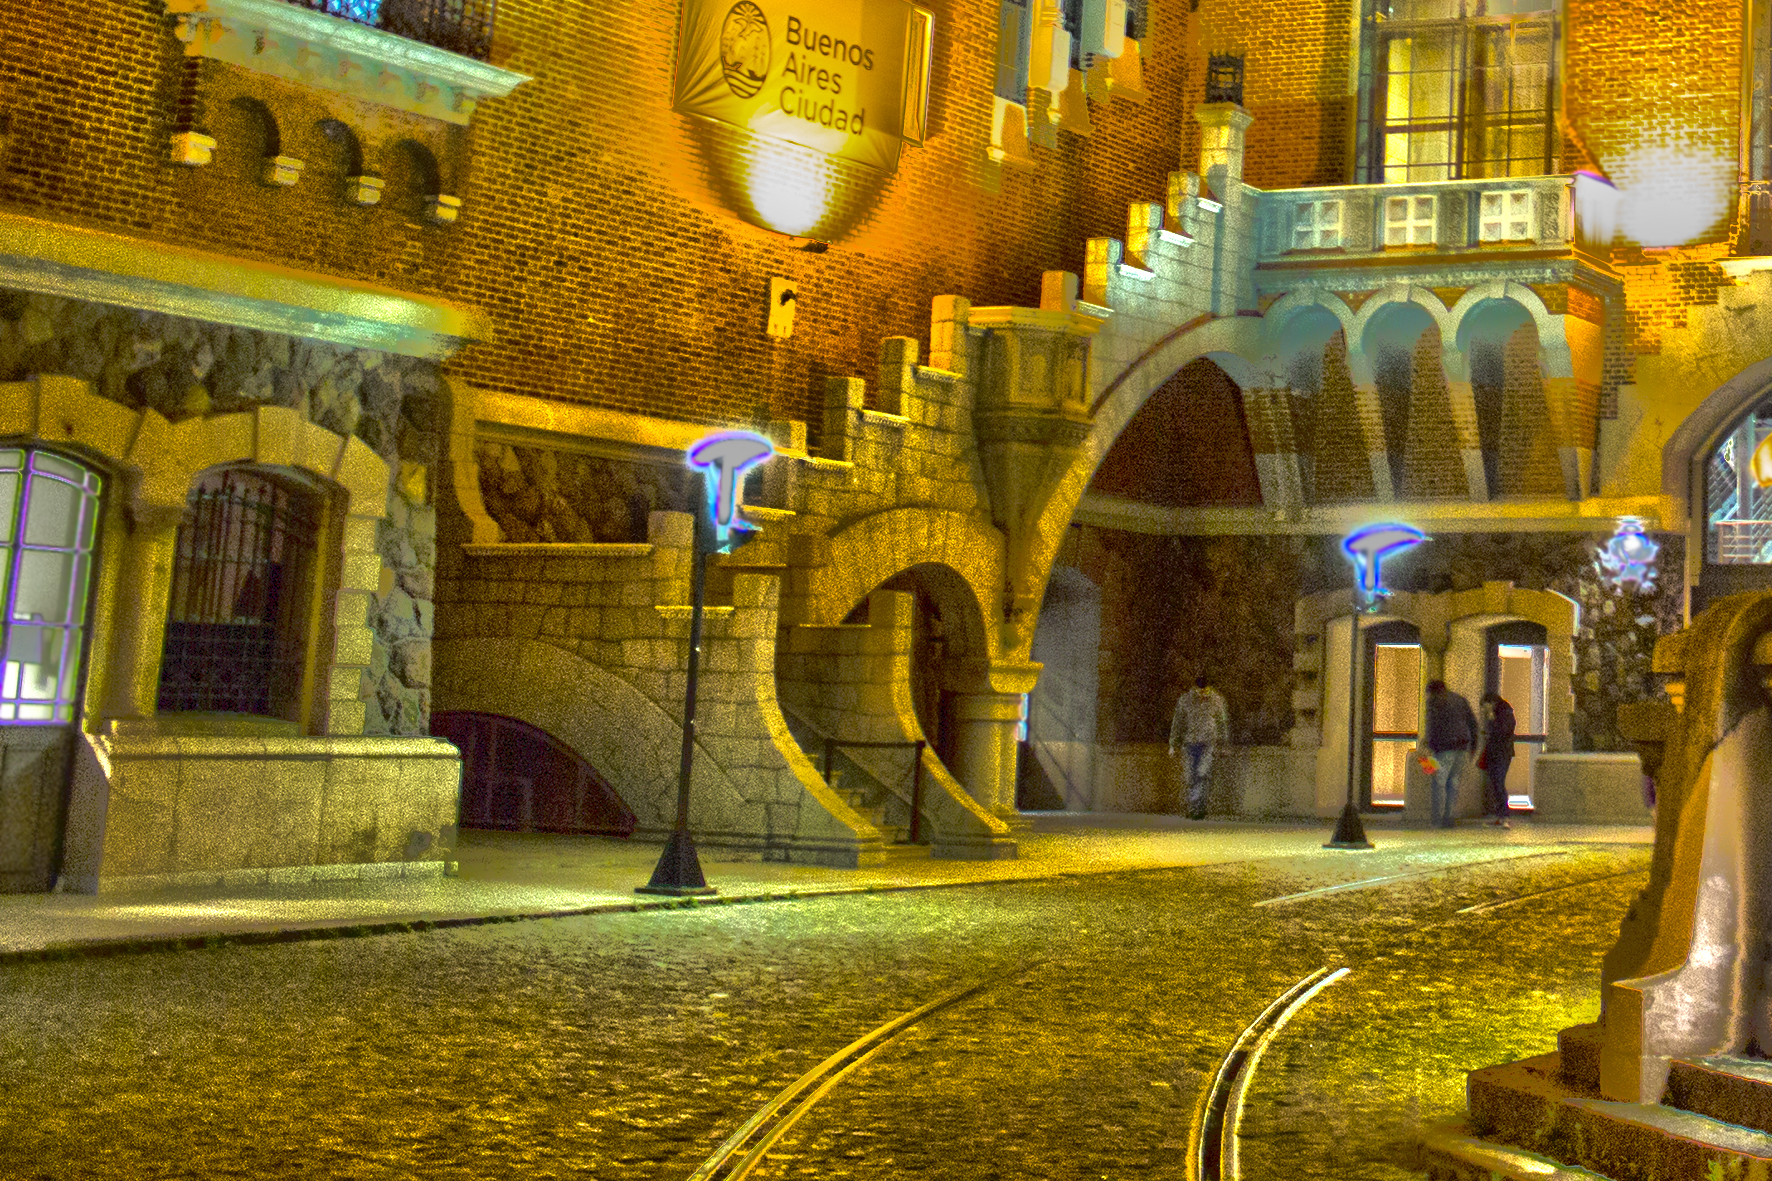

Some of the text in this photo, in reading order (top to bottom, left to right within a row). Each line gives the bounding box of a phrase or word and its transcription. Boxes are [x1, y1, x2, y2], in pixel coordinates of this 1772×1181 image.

[786, 15, 875, 71] Buenos
[781, 51, 842, 95] Aires
[780, 85, 865, 136] Ciudad
